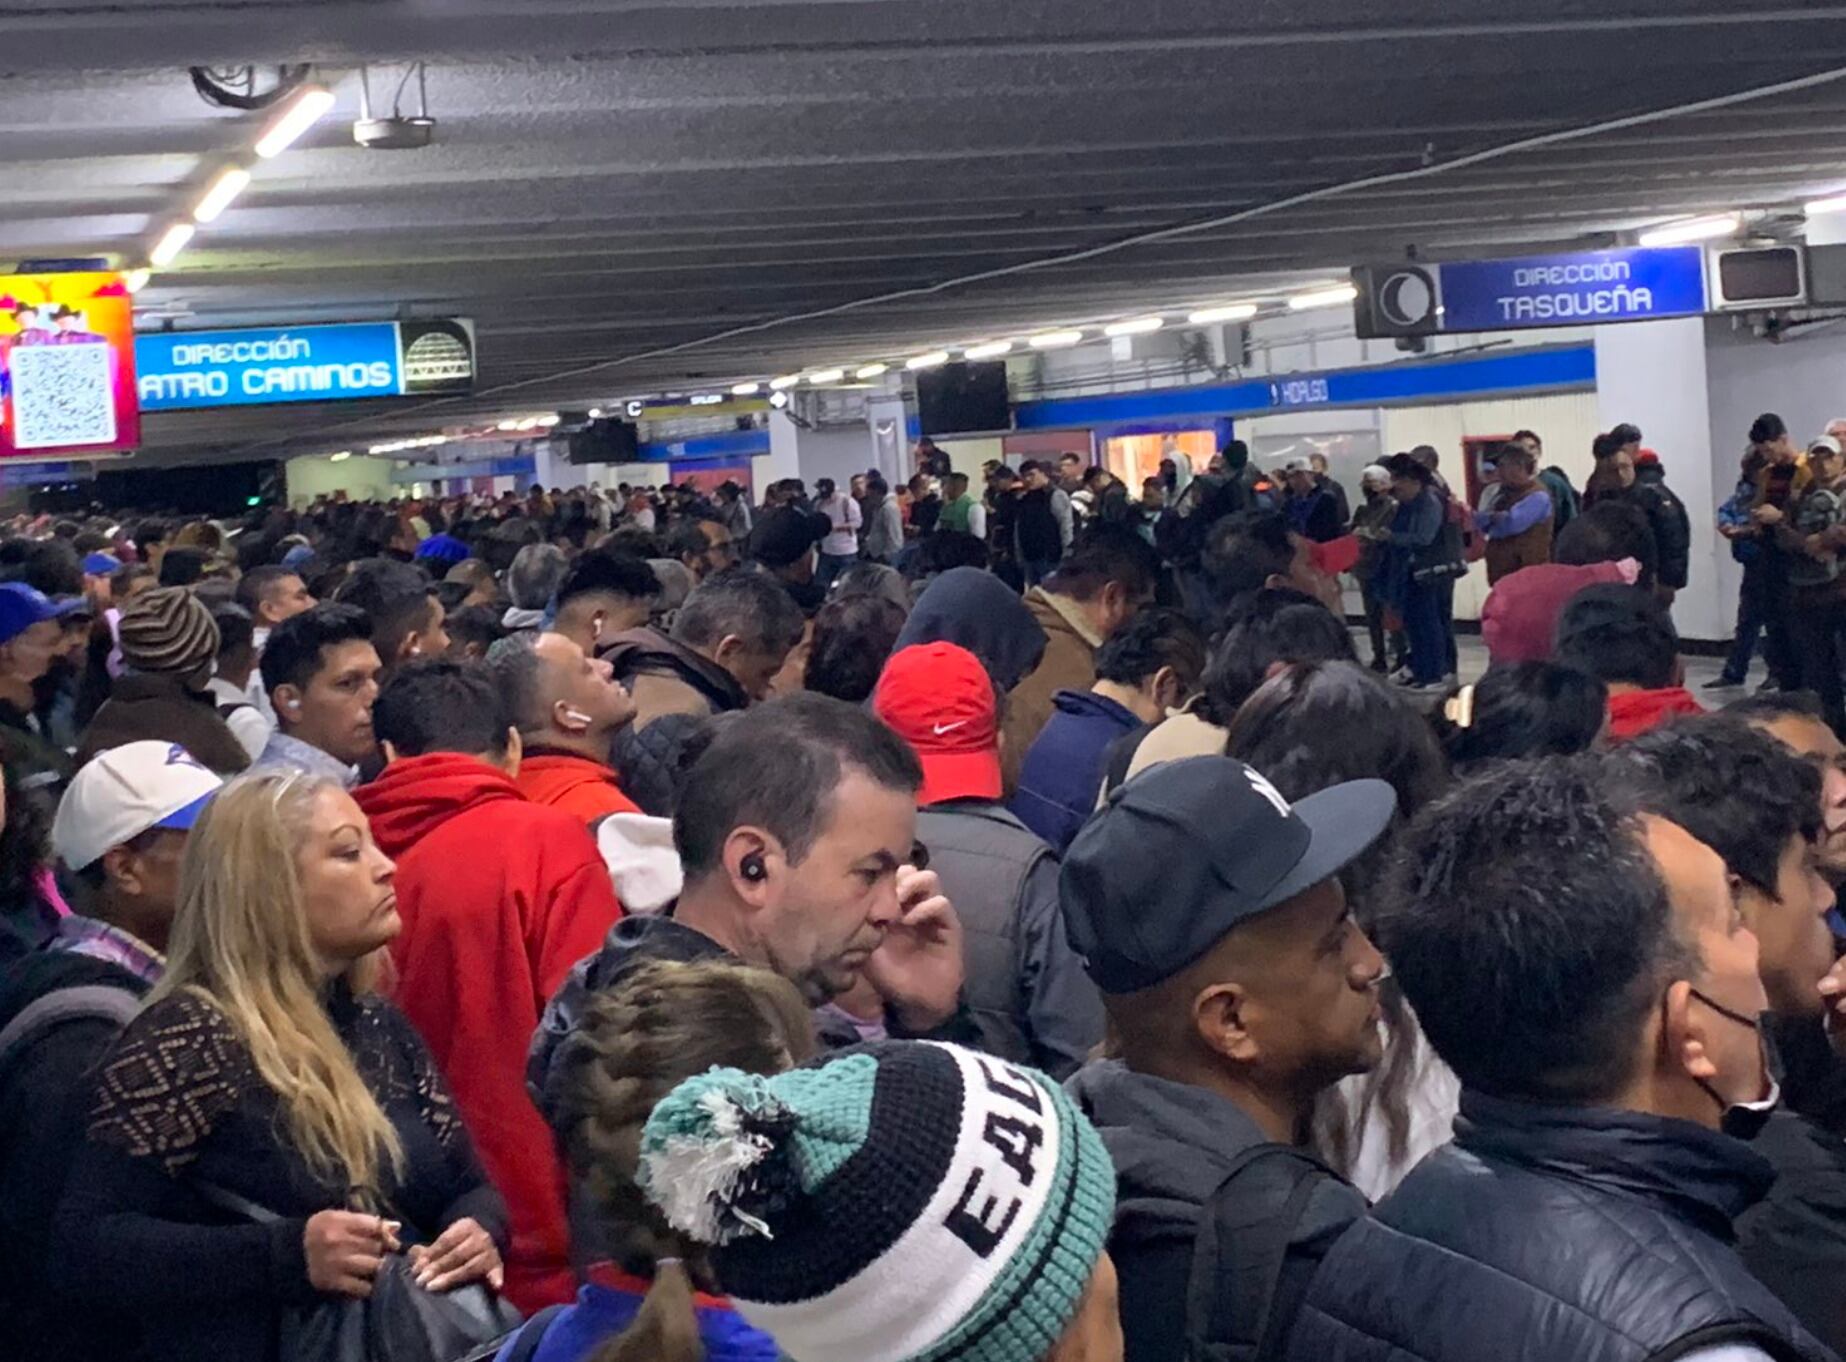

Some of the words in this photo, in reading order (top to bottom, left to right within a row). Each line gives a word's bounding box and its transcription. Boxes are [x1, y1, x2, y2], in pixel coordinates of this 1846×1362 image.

[1514, 259, 1630, 287] DIRECCIÓN
[1498, 284, 1652, 320] TASQUEÑA
[172, 335, 310, 366] DIRECCIÓN
[242, 361, 392, 394] CAMINOS
